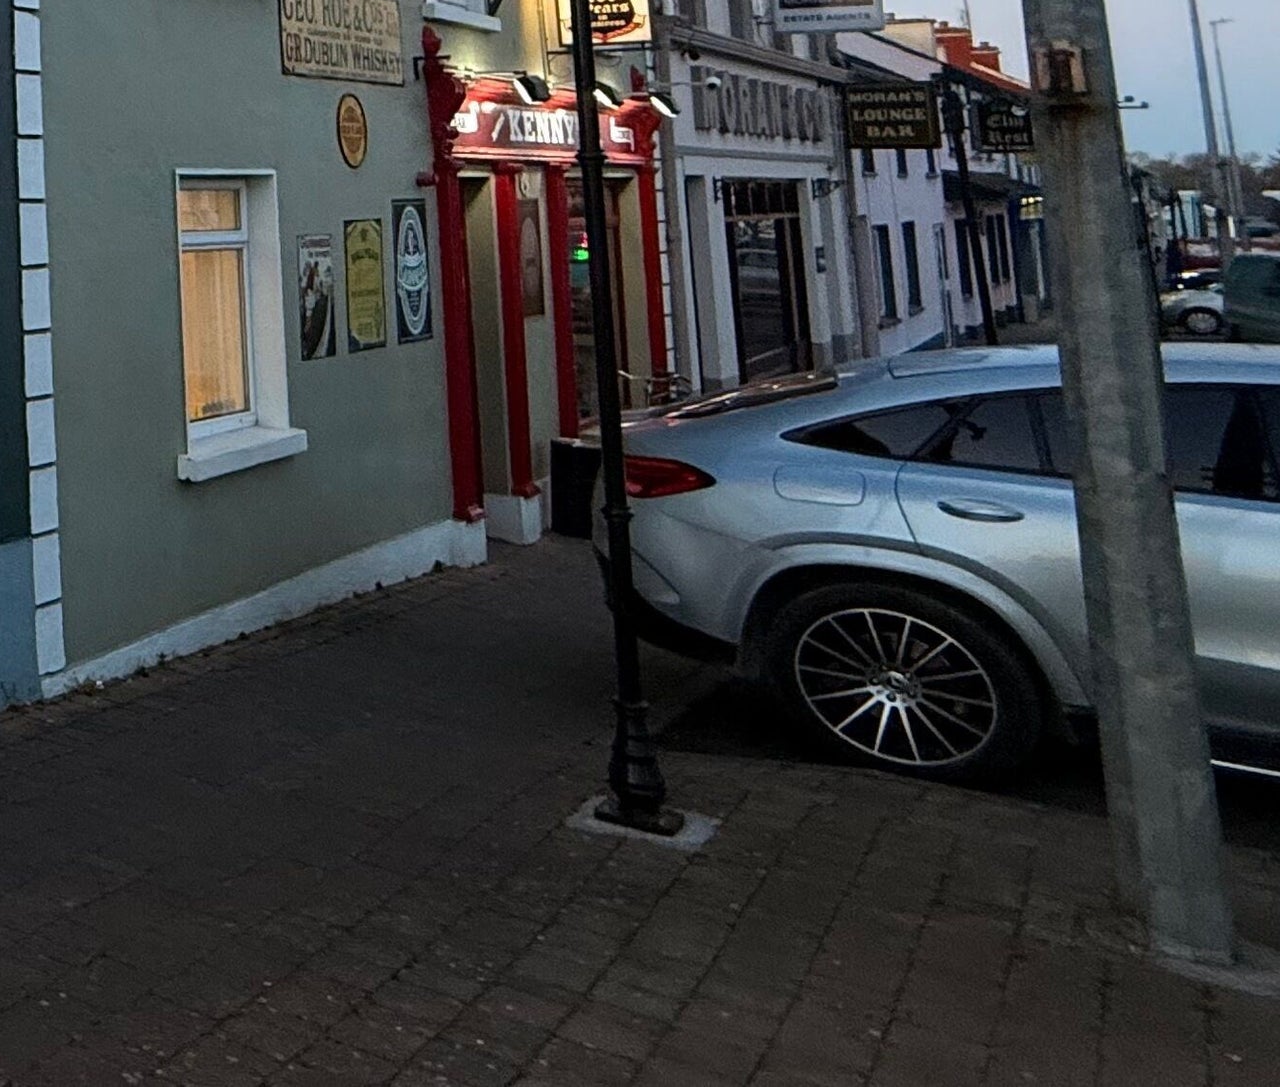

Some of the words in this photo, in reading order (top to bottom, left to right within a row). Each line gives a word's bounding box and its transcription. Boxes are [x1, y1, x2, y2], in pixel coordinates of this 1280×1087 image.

[782, 13, 823, 23] ESTATE
[304, 37, 348, 68] DUBLIN
[350, 43, 401, 74] WHISKEY
[848, 90, 925, 103] MORAN'S
[852, 107, 927, 122] LOUNGE
[866, 124, 916, 138] BAR
